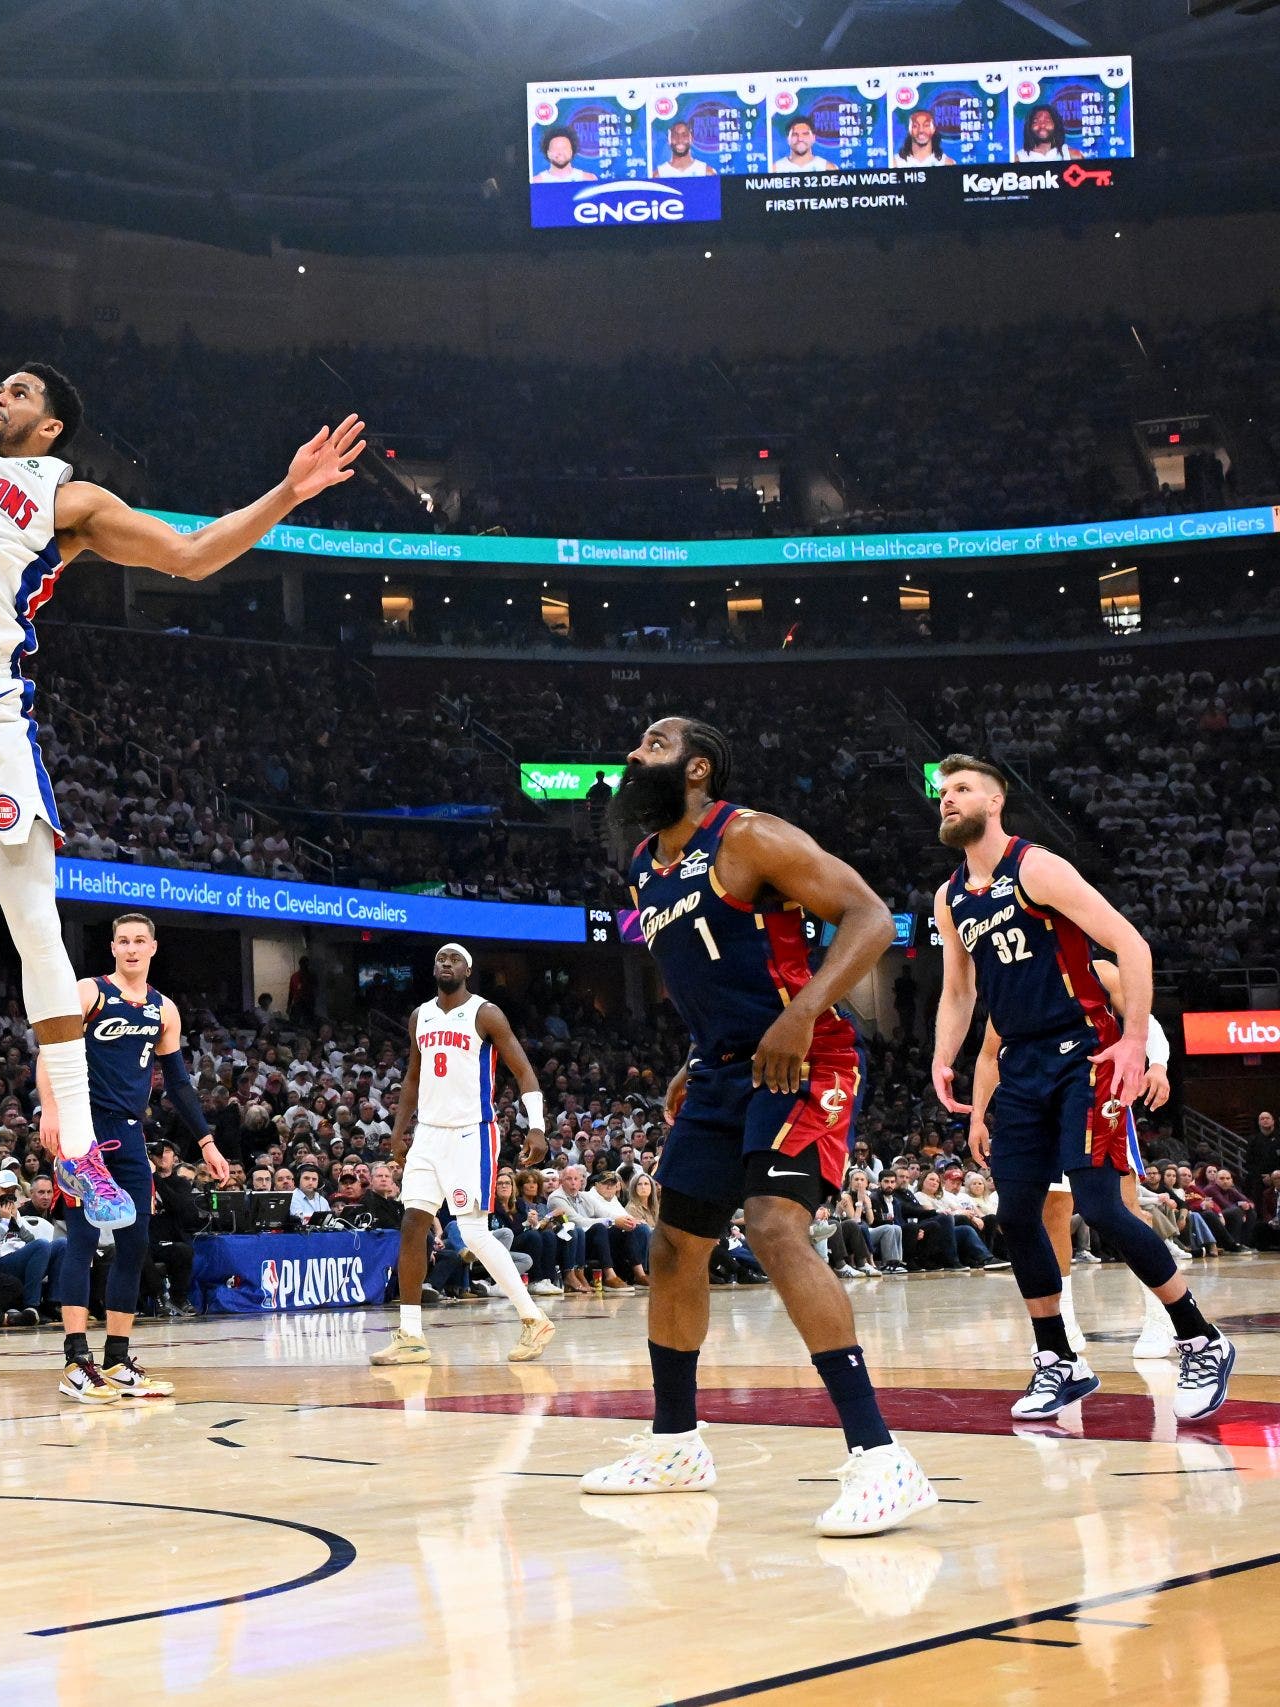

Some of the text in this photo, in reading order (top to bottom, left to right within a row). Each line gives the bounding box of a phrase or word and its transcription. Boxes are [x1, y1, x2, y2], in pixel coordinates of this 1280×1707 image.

[986, 74, 1001, 82] 24
[1108, 68, 1123, 76] 28
[866, 104, 872, 112] 7
[867, 127, 872, 135] 7
[746, 178, 800, 190] NUMBER
[860, 173, 901, 185] WADE.
[905, 172, 926, 183] HIS
[963, 170, 1059, 195] KeyBank
[852, 195, 908, 208] FOURTH.
[262, 530, 461, 558] of the Cleveland Cavaliers
[782, 515, 1265, 562] Official Healthcare Provider of the Cleveland Cavaliers
[582, 544, 688, 561] Cleveland Clinic
[527, 770, 580, 792] Sprite
[682, 865, 707, 877] CLIFFS
[69, 868, 155, 899] Healthcare
[161, 878, 222, 905] Provider
[227, 886, 243, 907] of
[247, 888, 270, 909] the
[275, 890, 342, 916] Cleveland
[347, 898, 407, 923] Cavaliers
[590, 910, 611, 922] FG%
[593, 928, 607, 942] 36
[694, 917, 721, 961] 1
[991, 927, 1033, 964] 32
[418, 1031, 471, 1051] PISTONS
[1227, 1021, 1280, 1043] fubo
[139, 1042, 154, 1068] 5
[434, 1052, 447, 1077] 8
[280, 1257, 365, 1303] PLAYOFFS
